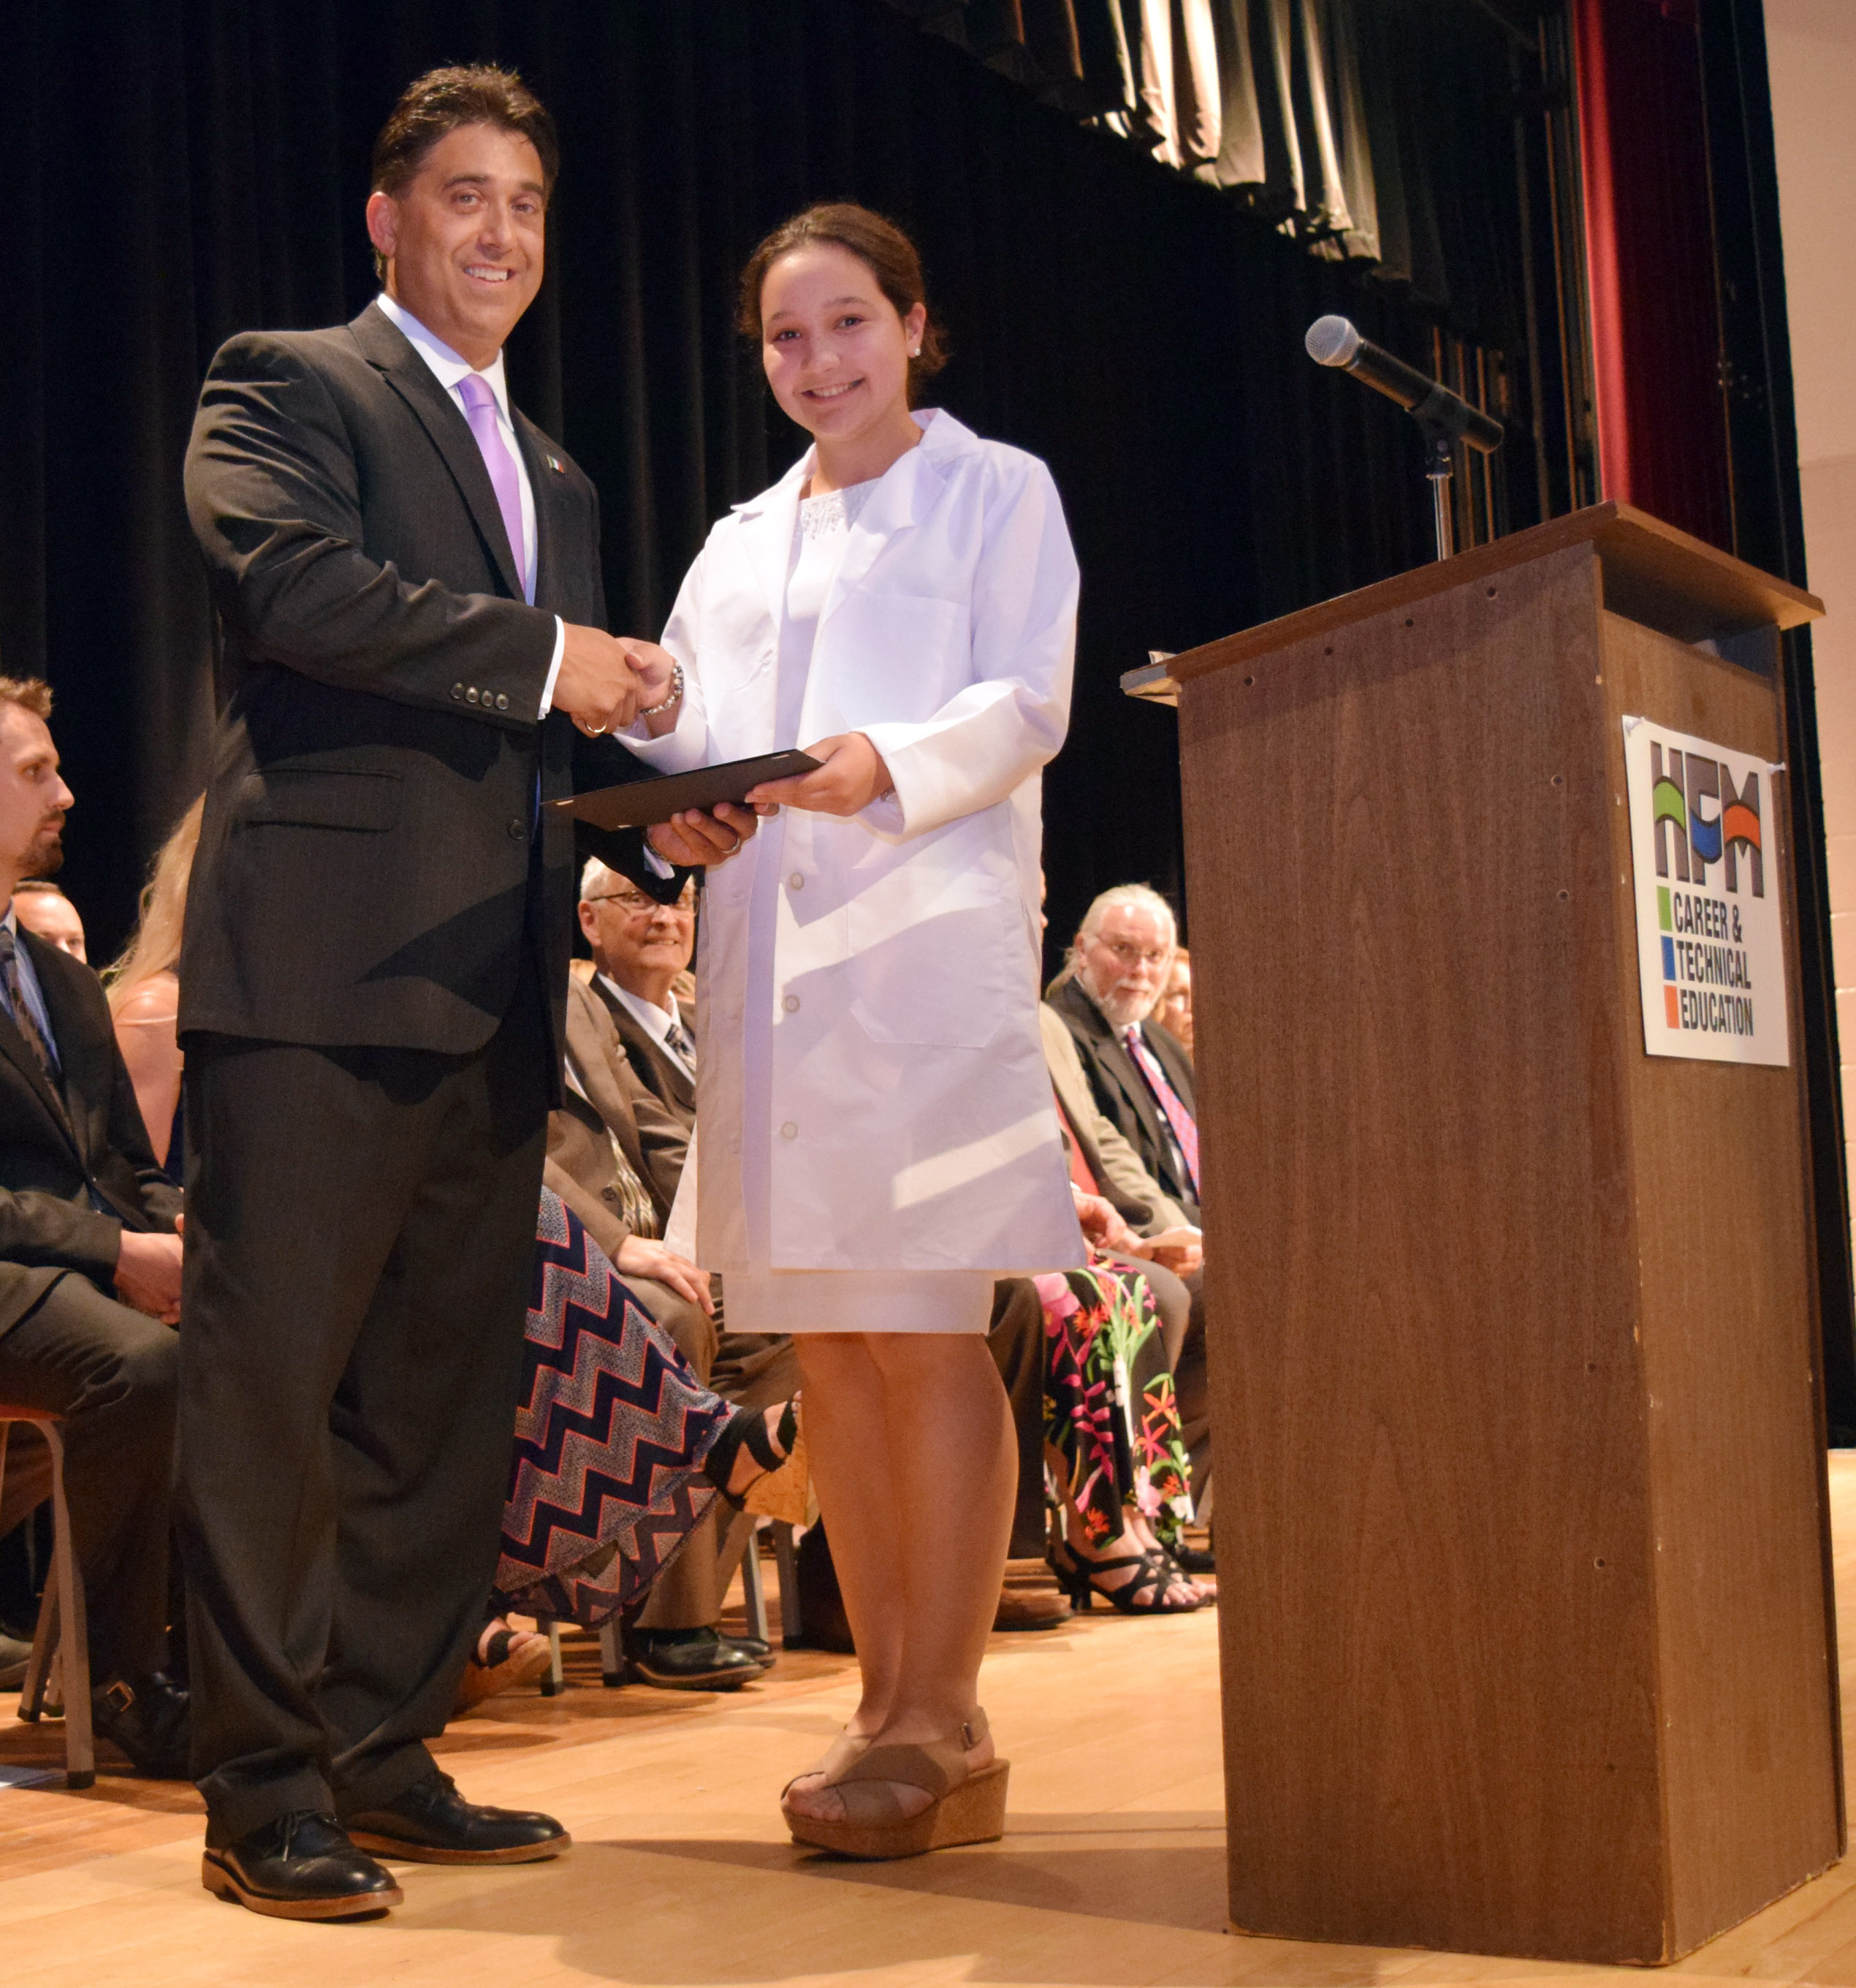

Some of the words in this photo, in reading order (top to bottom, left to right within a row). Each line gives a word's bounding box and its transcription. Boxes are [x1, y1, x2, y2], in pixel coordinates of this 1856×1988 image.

[1651, 740, 1764, 898] HFM
[1673, 892, 1728, 939] CAREER
[1732, 904, 1743, 943] &
[1676, 940, 1752, 990] TECHNICAL
[1680, 988, 1754, 1036] EDUCATION
